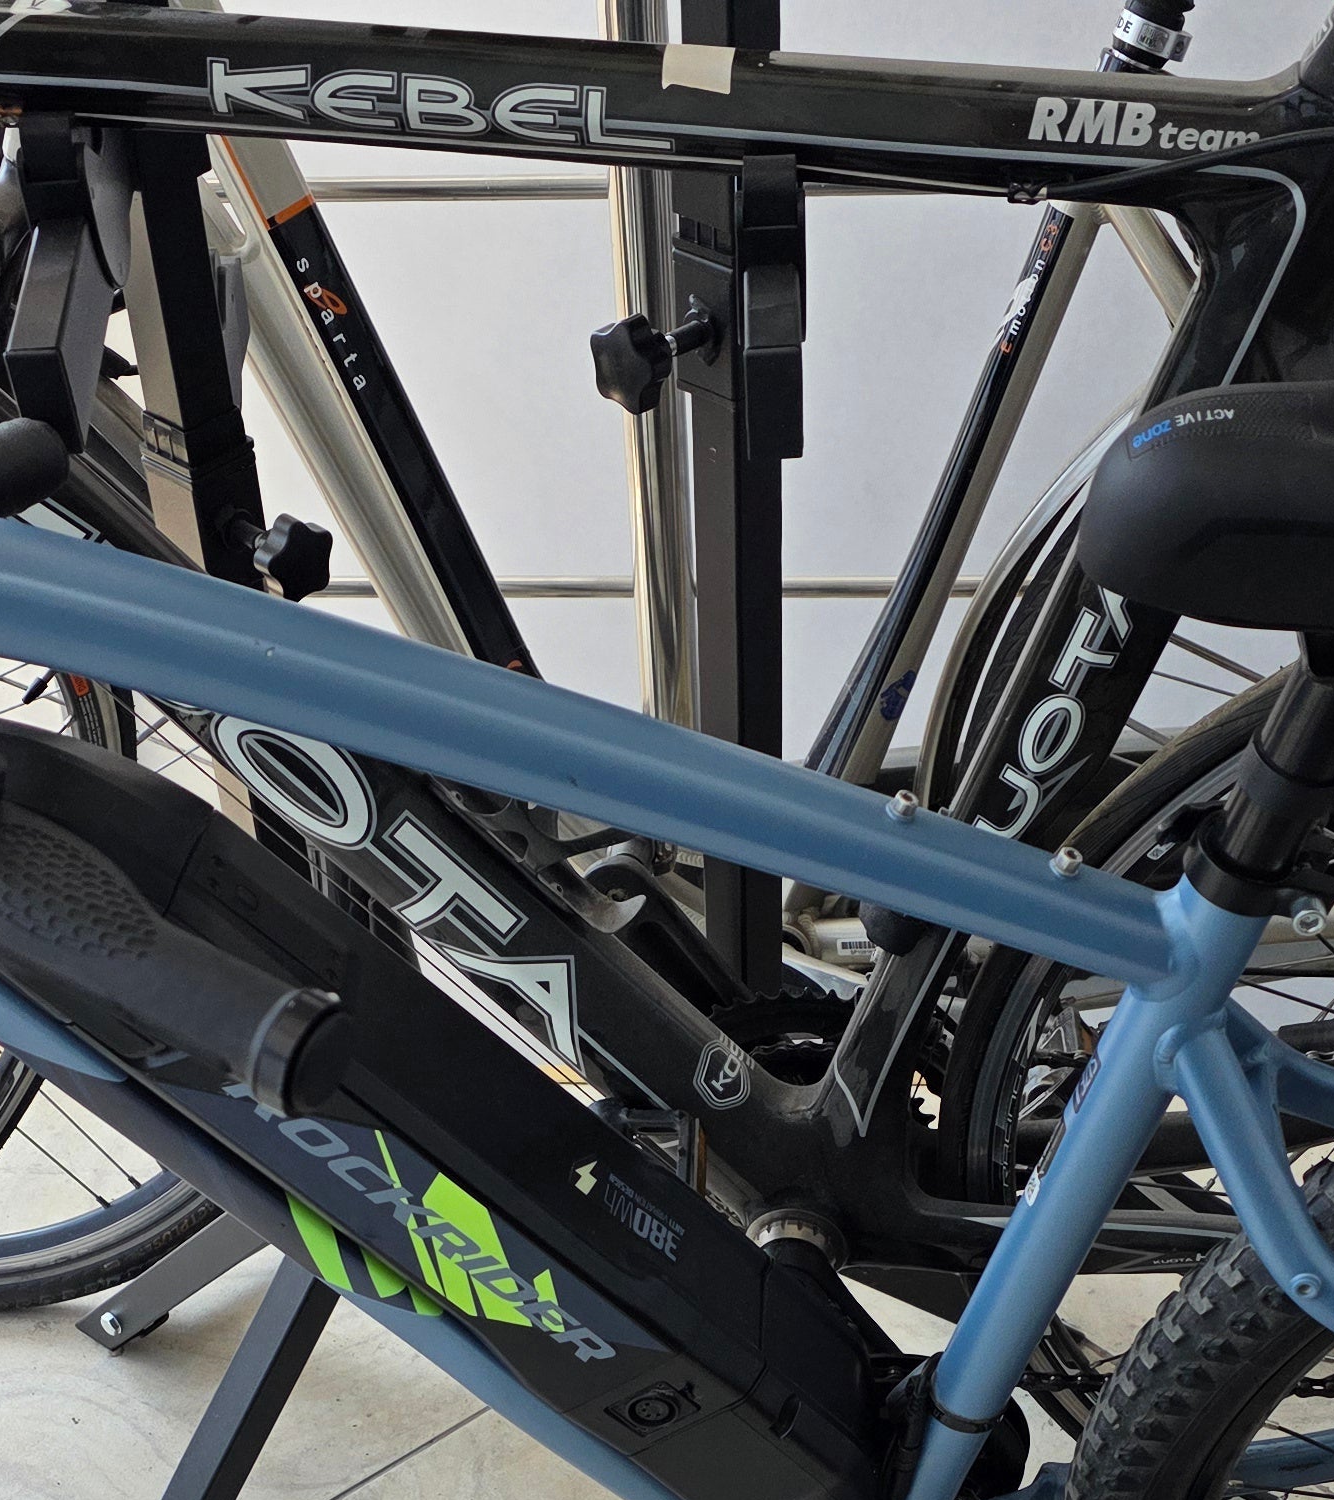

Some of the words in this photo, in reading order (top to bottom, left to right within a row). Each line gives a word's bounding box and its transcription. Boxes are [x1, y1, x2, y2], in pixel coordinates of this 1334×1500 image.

[207, 56, 675, 152] KEBEL
[1028, 97, 1156, 147] RMB
[1158, 121, 1260, 151] team
[296, 257, 367, 391] sparta
[1131, 419, 1173, 451] zone
[1175, 408, 1236, 428] ACTIVE
[604, 1183, 682, 1263] 380Wh
